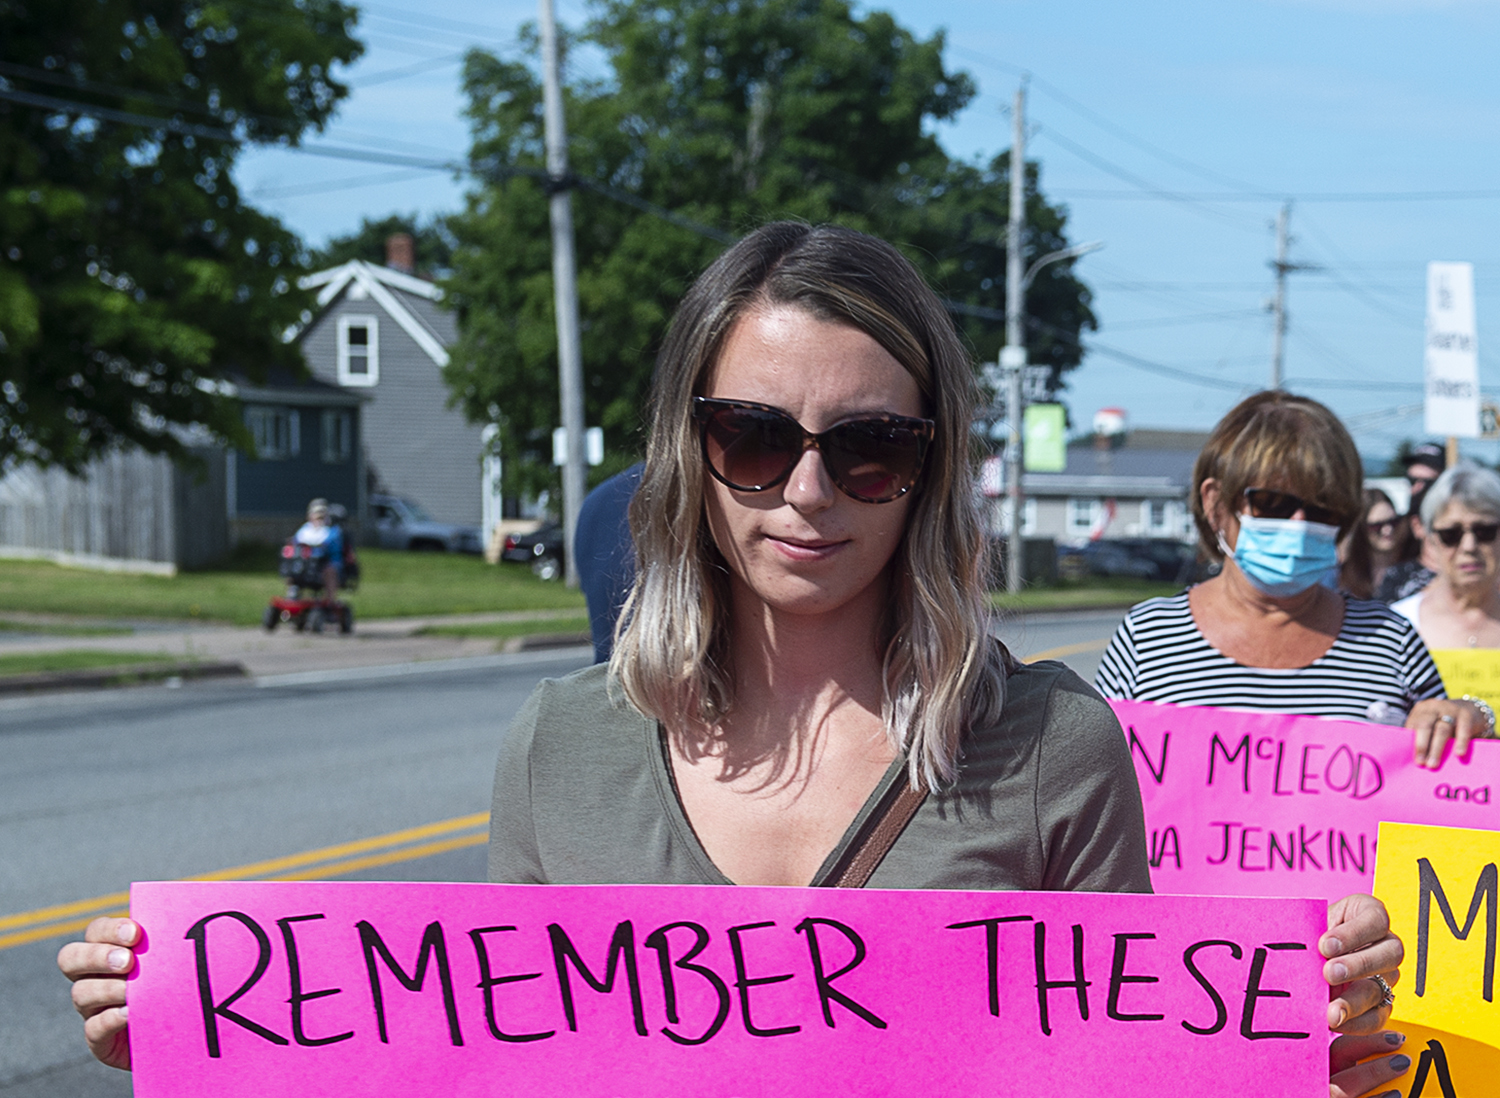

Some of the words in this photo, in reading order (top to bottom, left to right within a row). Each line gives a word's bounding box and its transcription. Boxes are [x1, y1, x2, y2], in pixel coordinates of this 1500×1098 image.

[1206, 731, 1384, 800] McLEOD
[1433, 782, 1491, 805] and
[1206, 820, 1377, 875] JENKIN
[183, 910, 888, 1058] REMEMBER
[945, 914, 1311, 1041] THESE
